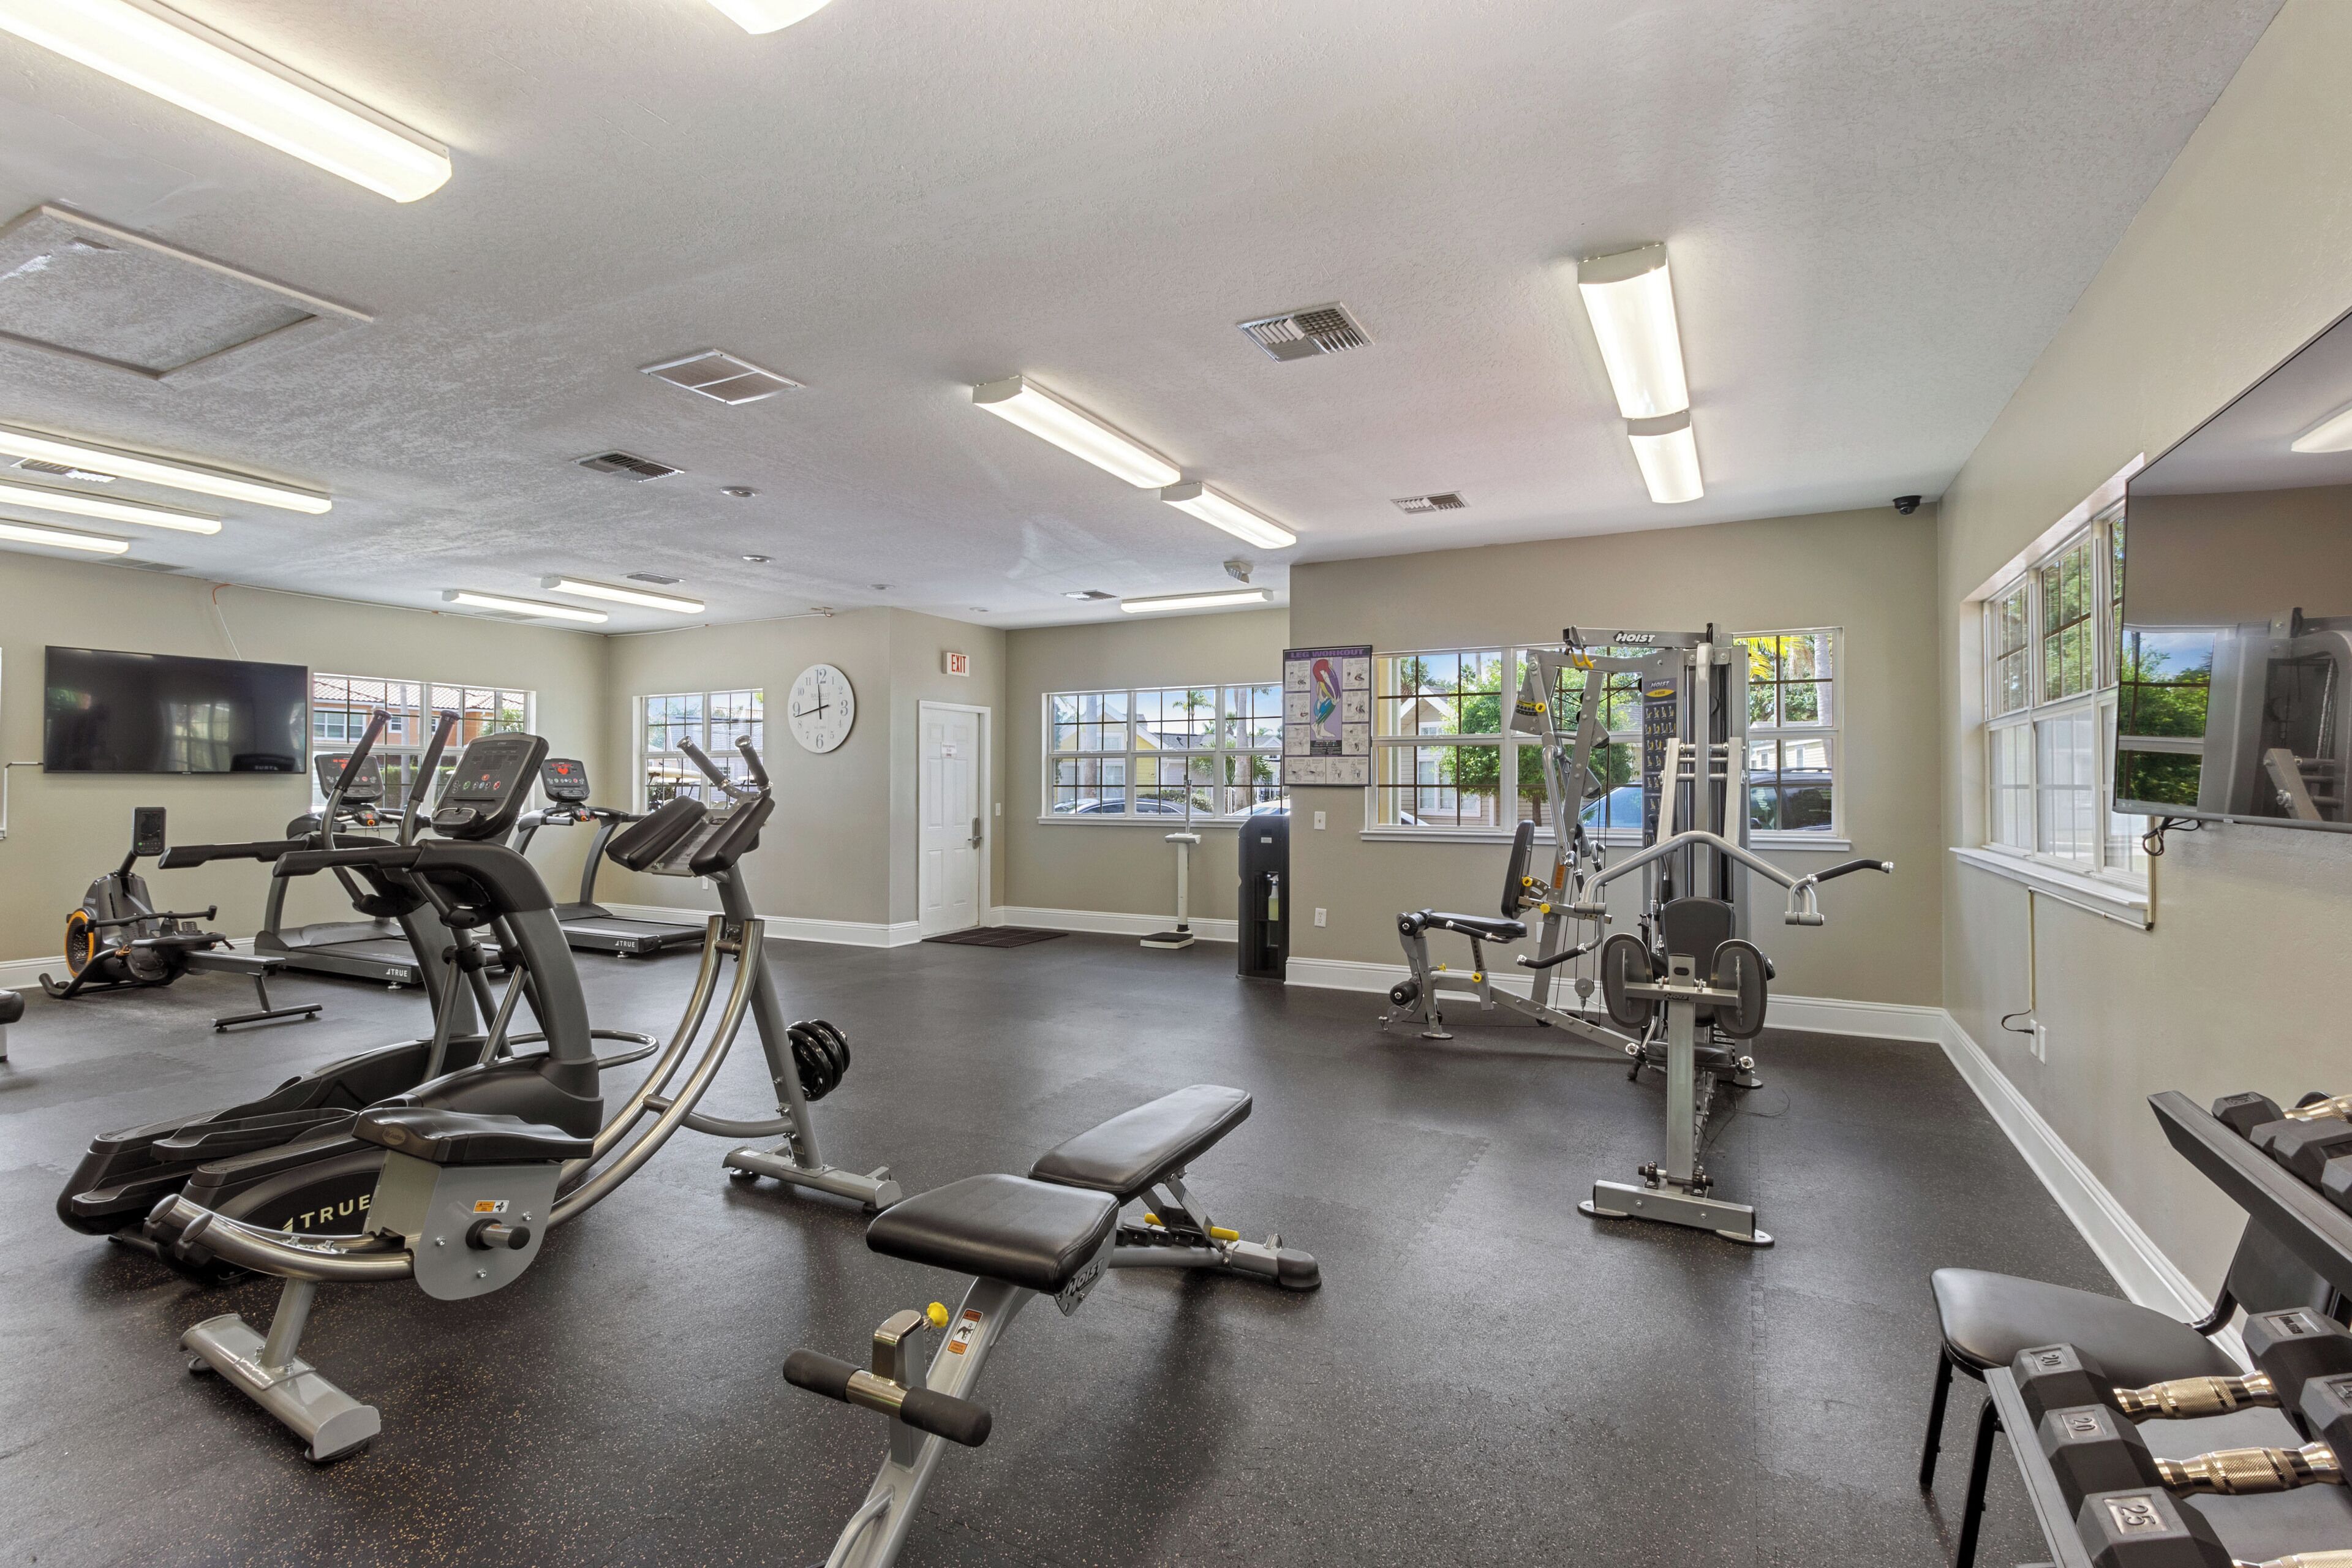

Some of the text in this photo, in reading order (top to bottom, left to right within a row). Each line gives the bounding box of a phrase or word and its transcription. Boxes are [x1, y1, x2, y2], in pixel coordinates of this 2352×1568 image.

[1615, 633, 1656, 643] HOIST
[951, 654, 967, 673] EXIT
[805, 677, 812, 686] 11
[815, 668, 827, 684] 12
[797, 687, 805, 696] 10
[838, 686, 843, 695] 2
[793, 701, 801, 717] 9
[840, 699, 848, 717] 3
[797, 720, 802, 729] 8
[805, 731, 810, 740] 7
[816, 733, 824, 749] 6
[829, 731, 835, 739] 5
[391, 968, 407, 977] TRUE
[300, 1194, 370, 1228] TRUE
[1066, 1257, 1104, 1297] HOIST
[2041, 1354, 2062, 1366] 20
[2071, 1417, 2096, 1431] 20
[2120, 1504, 2157, 1526] 25
